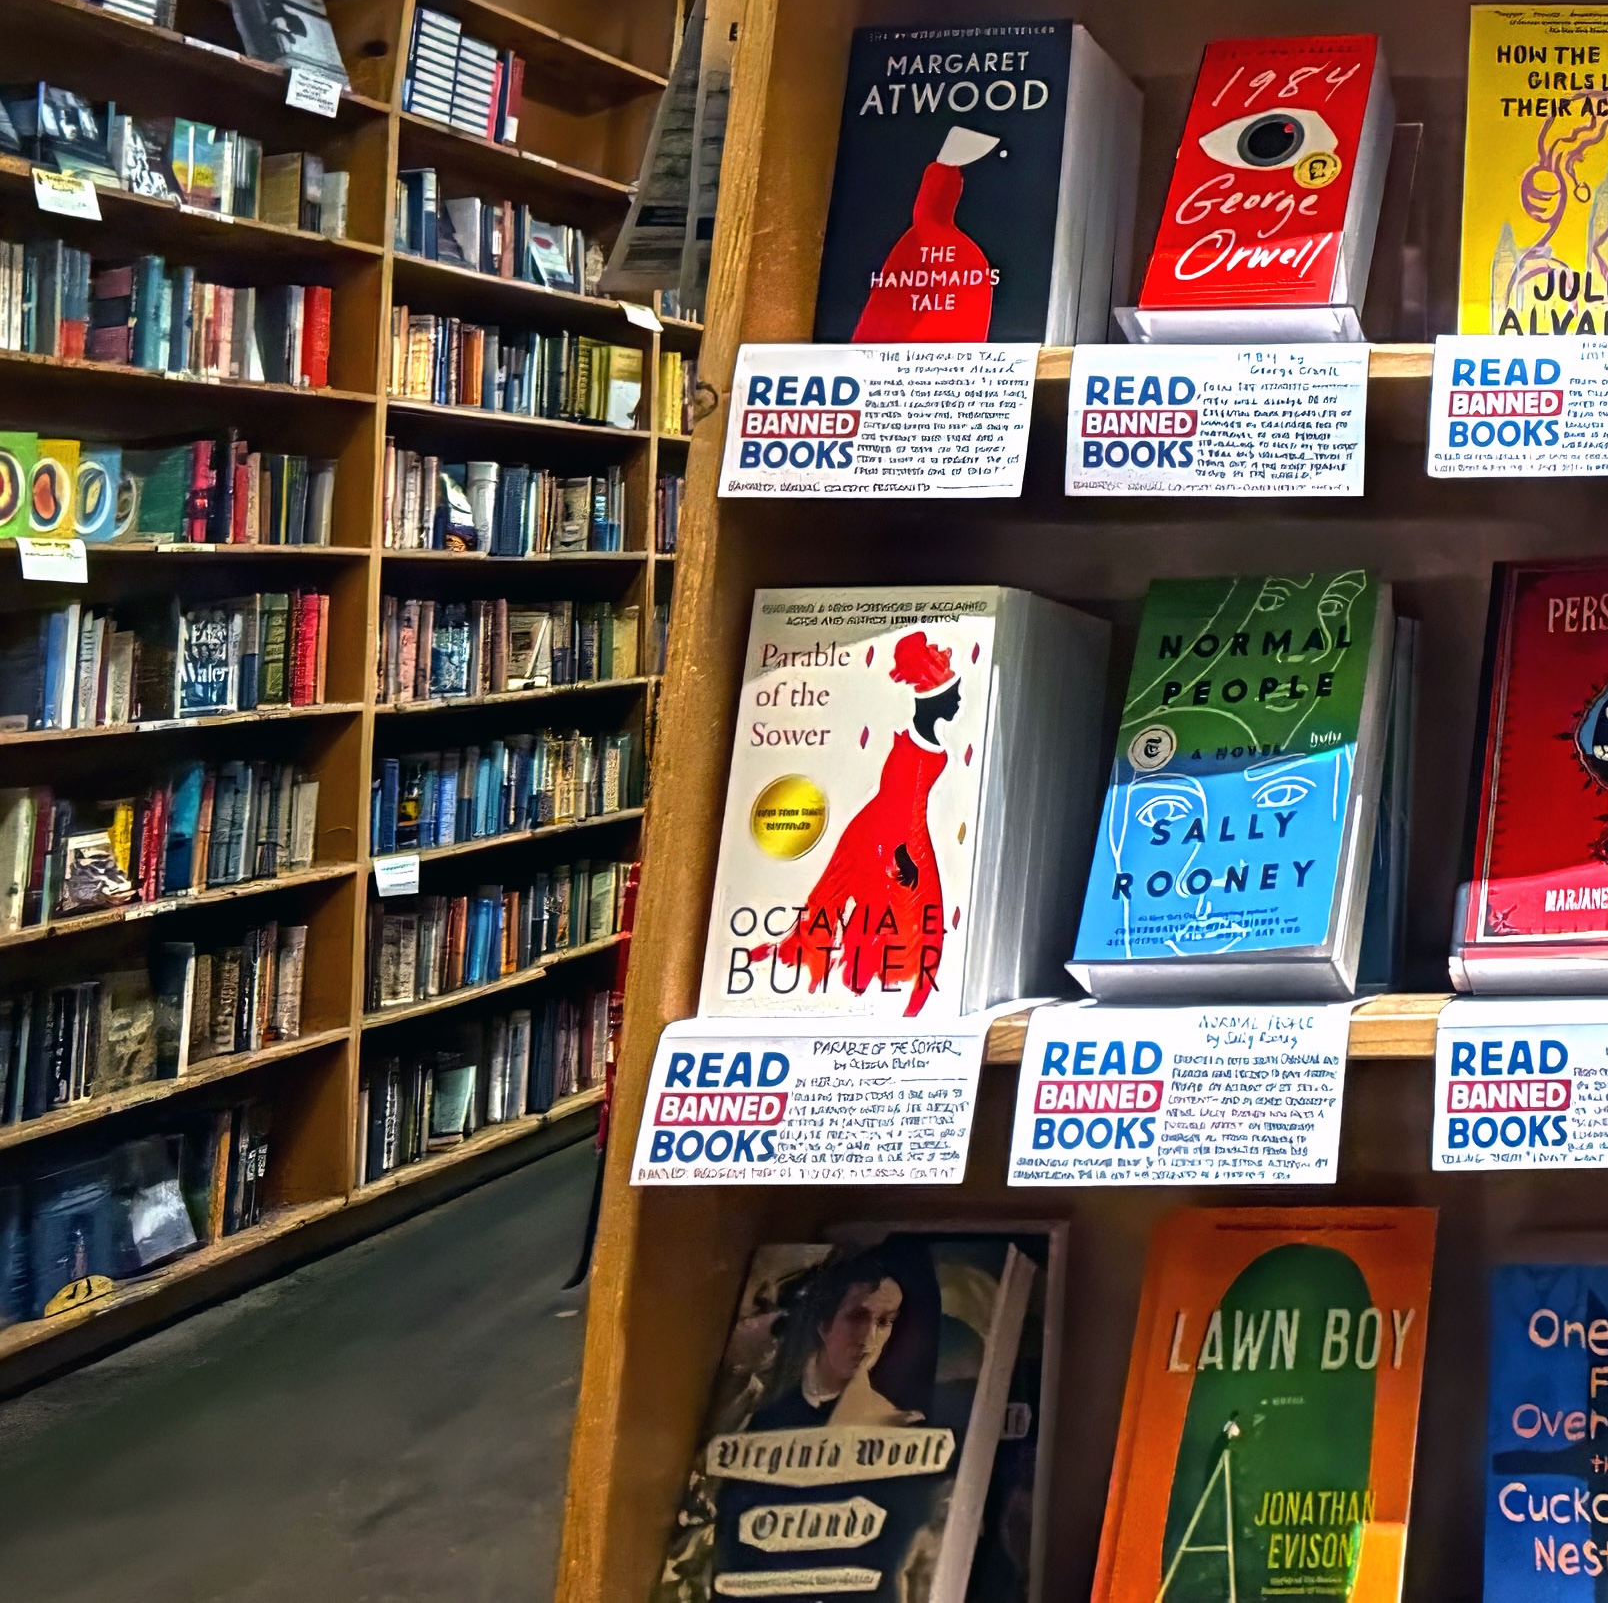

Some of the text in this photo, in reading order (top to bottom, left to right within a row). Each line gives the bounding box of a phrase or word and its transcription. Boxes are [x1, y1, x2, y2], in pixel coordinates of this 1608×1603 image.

[887, 52, 1030, 76] MARGARET
[1497, 45, 1546, 64] HOW
[1554, 46, 1600, 65] THE
[1212, 63, 1360, 107] 1984
[1528, 72, 1594, 90] GIRLS
[859, 80, 1048, 116] ATWOOD
[1500, 98, 1571, 117] THEIR
[1175, 173, 1318, 238] George
[920, 246, 956, 263] THE
[1175, 229, 1333, 281] Orwell
[870, 268, 1000, 289] HANDMAID'S
[911, 293, 956, 313] TALE
[1452, 358, 1561, 387] READ
[746, 375, 860, 406] READ
[1086, 375, 1195, 406] READ
[1451, 391, 1560, 415] BANNED
[744, 412, 855, 436] BANNED
[1085, 411, 1193, 435] BANNED
[1448, 420, 1560, 448] BOOKS
[739, 440, 854, 469] BOOKS
[1082, 440, 1194, 469] BOOKS
[760, 642, 850, 668] Parable
[1158, 625, 1354, 660] NORMAL
[756, 682, 830, 707] of the
[1161, 671, 1335, 707] PEOPLE
[751, 722, 830, 747] Sower
[1150, 811, 1298, 845] SALLY
[1112, 859, 1315, 900] ROONEY
[1545, 887, 1608, 913] MARJANE
[731, 904, 900, 939] OCTAVIA
[727, 946, 941, 996] BUTLER
[665, 1052, 790, 1088] READ
[1041, 1040, 1163, 1077] READ
[1451, 1041, 1569, 1077] READ
[658, 1095, 785, 1123] BANNED
[1038, 1084, 1160, 1110] BANNED
[1450, 1083, 1568, 1110] BANNED
[649, 1129, 777, 1163] BOOKS
[1032, 1117, 1156, 1150] BOOKS
[1448, 1116, 1570, 1149] BOOKS
[1167, 1307, 1416, 1372] LAWN BOY
[1512, 1403, 1608, 1440] Over
[718, 1434, 947, 1475] Virginia Woolf
[752, 1507, 875, 1540] Orlando
[1254, 1491, 1376, 1526] JONATHAN
[1267, 1533, 1352, 1569] EVISON
